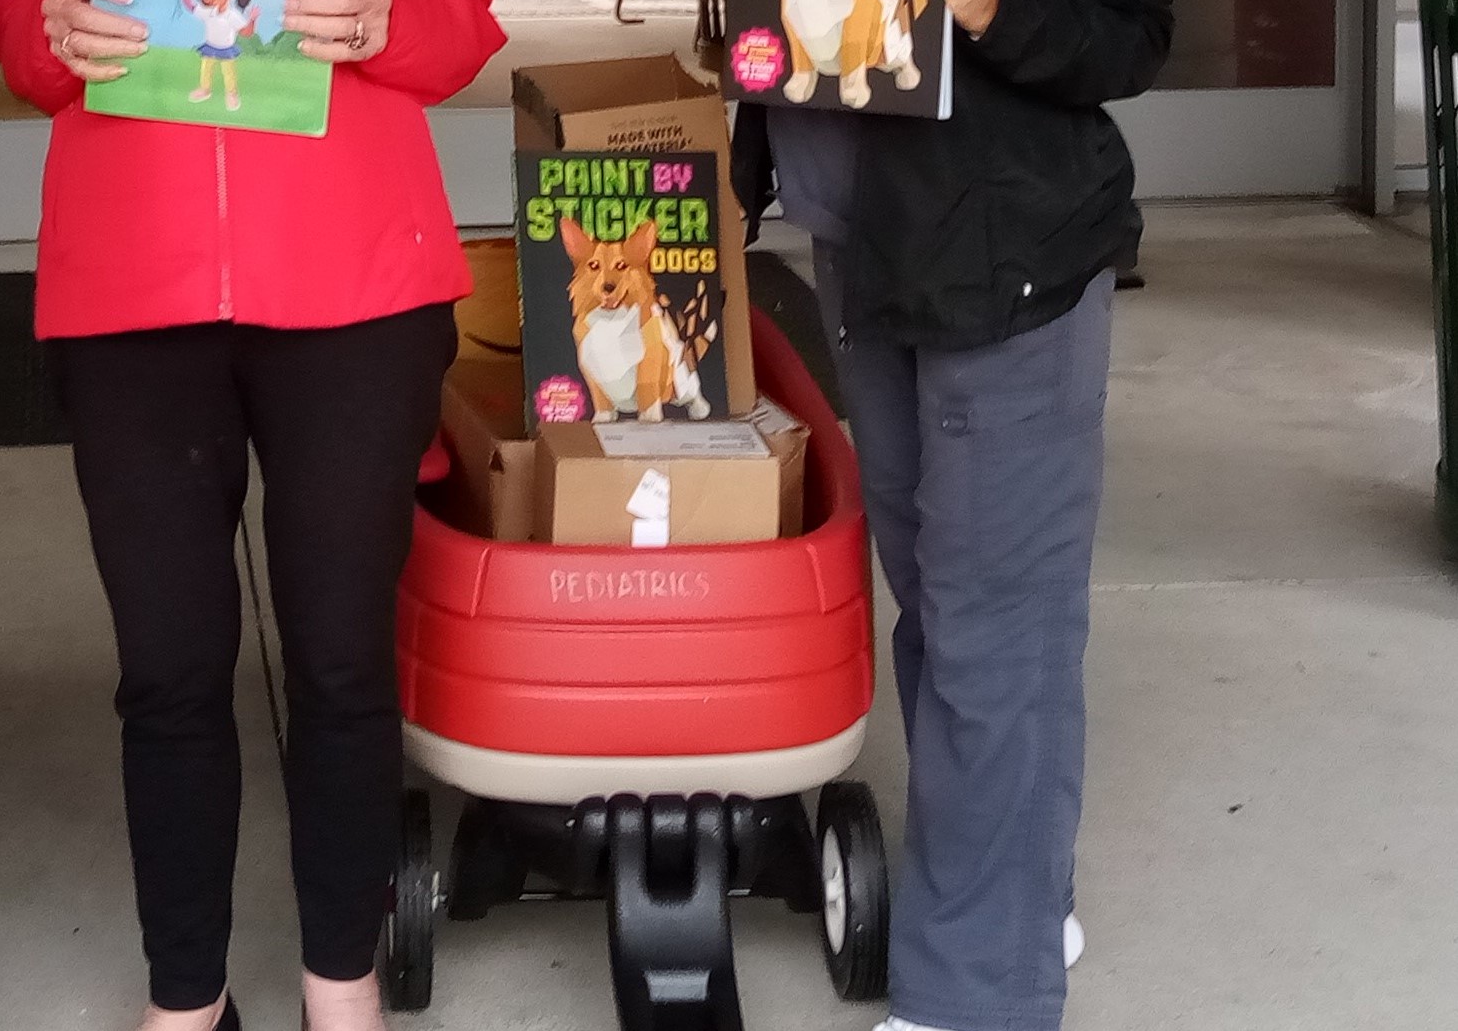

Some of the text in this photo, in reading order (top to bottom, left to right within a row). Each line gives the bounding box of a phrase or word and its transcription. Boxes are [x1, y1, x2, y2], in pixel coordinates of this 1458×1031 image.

[607, 125, 683, 145] MADE WITH
[539, 158, 693, 196] PAINT BY
[526, 196, 710, 243] STICKER
[650, 247, 718, 274] DOGS
[549, 570, 711, 604] PEDIATRICS
